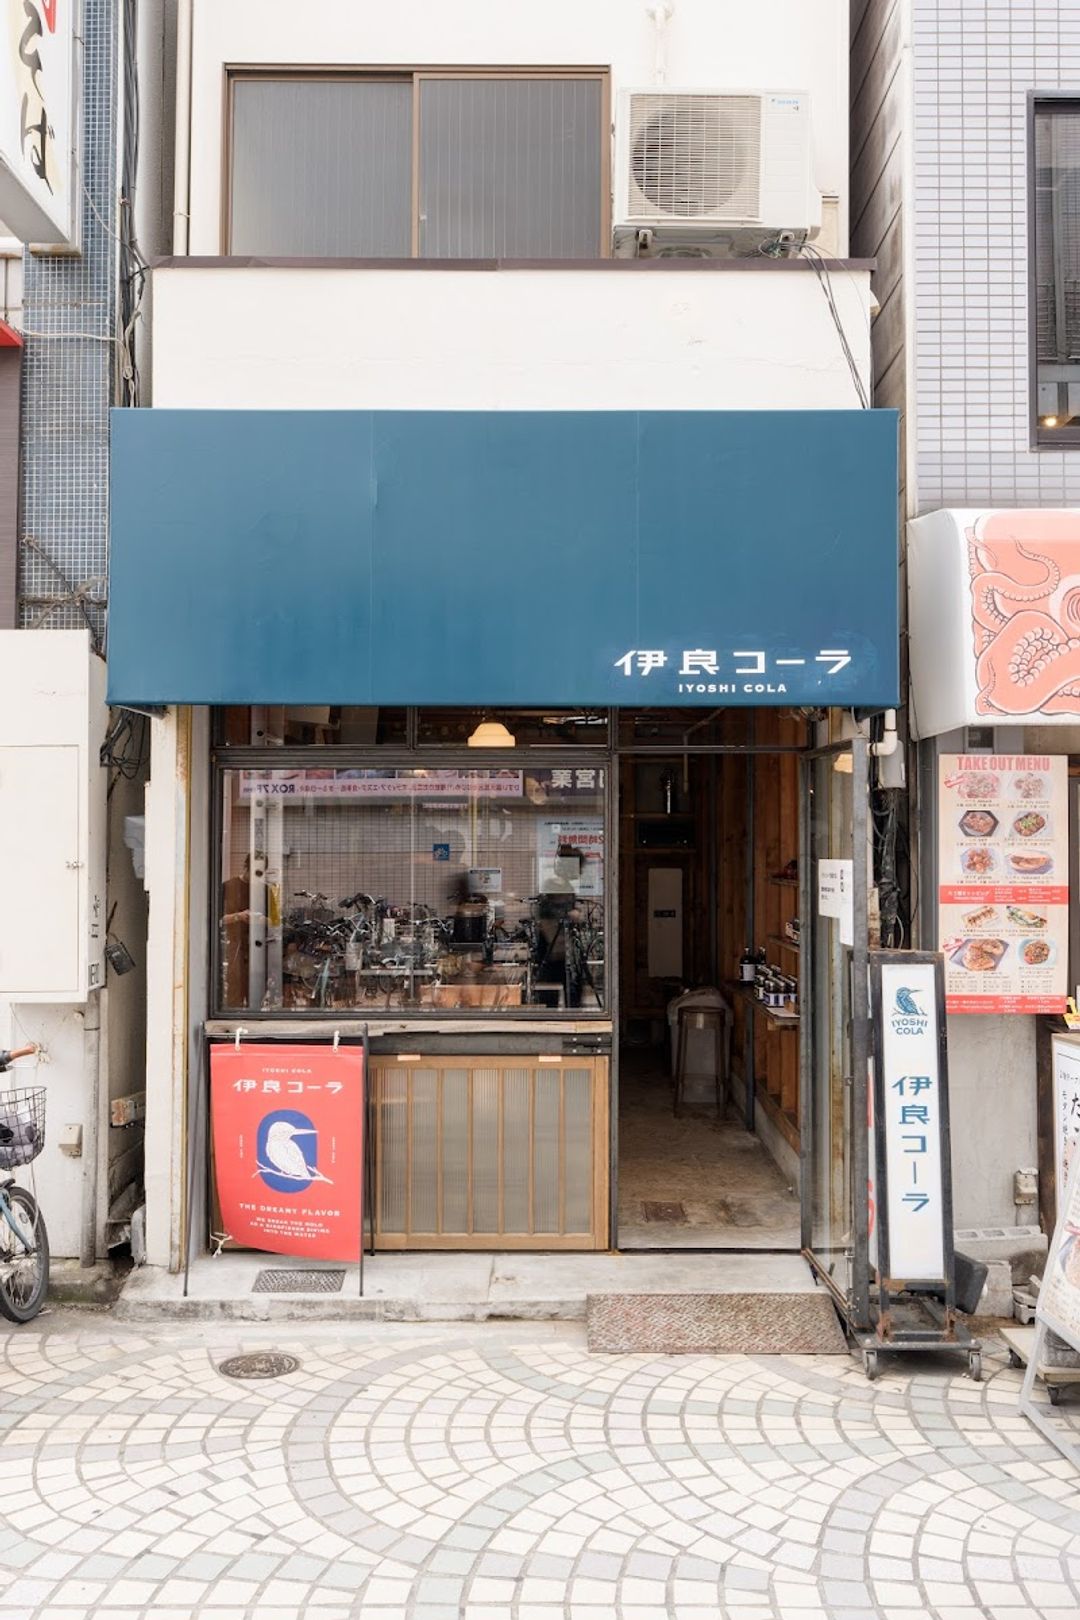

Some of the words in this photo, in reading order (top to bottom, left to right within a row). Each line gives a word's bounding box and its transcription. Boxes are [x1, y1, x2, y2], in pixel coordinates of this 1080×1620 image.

[613, 648, 852, 676] 伊良コーラ
[678, 683, 736, 693] IYOSHI
[743, 683, 787, 693] COLA
[956, 756, 988, 771] TAKE
[990, 756, 1013, 771] OUT
[1015, 756, 1050, 771] MENU
[891, 1018, 928, 1028] IYOSHI
[896, 1026, 924, 1035] COLA
[232, 1078, 344, 1094] 伊良コーラ
[891, 1075, 933, 1212] 伊良コーラ
[239, 1202, 256, 1211] THE
[259, 1204, 297, 1215] DREAMY
[301, 1208, 341, 1217] FLAVOR
